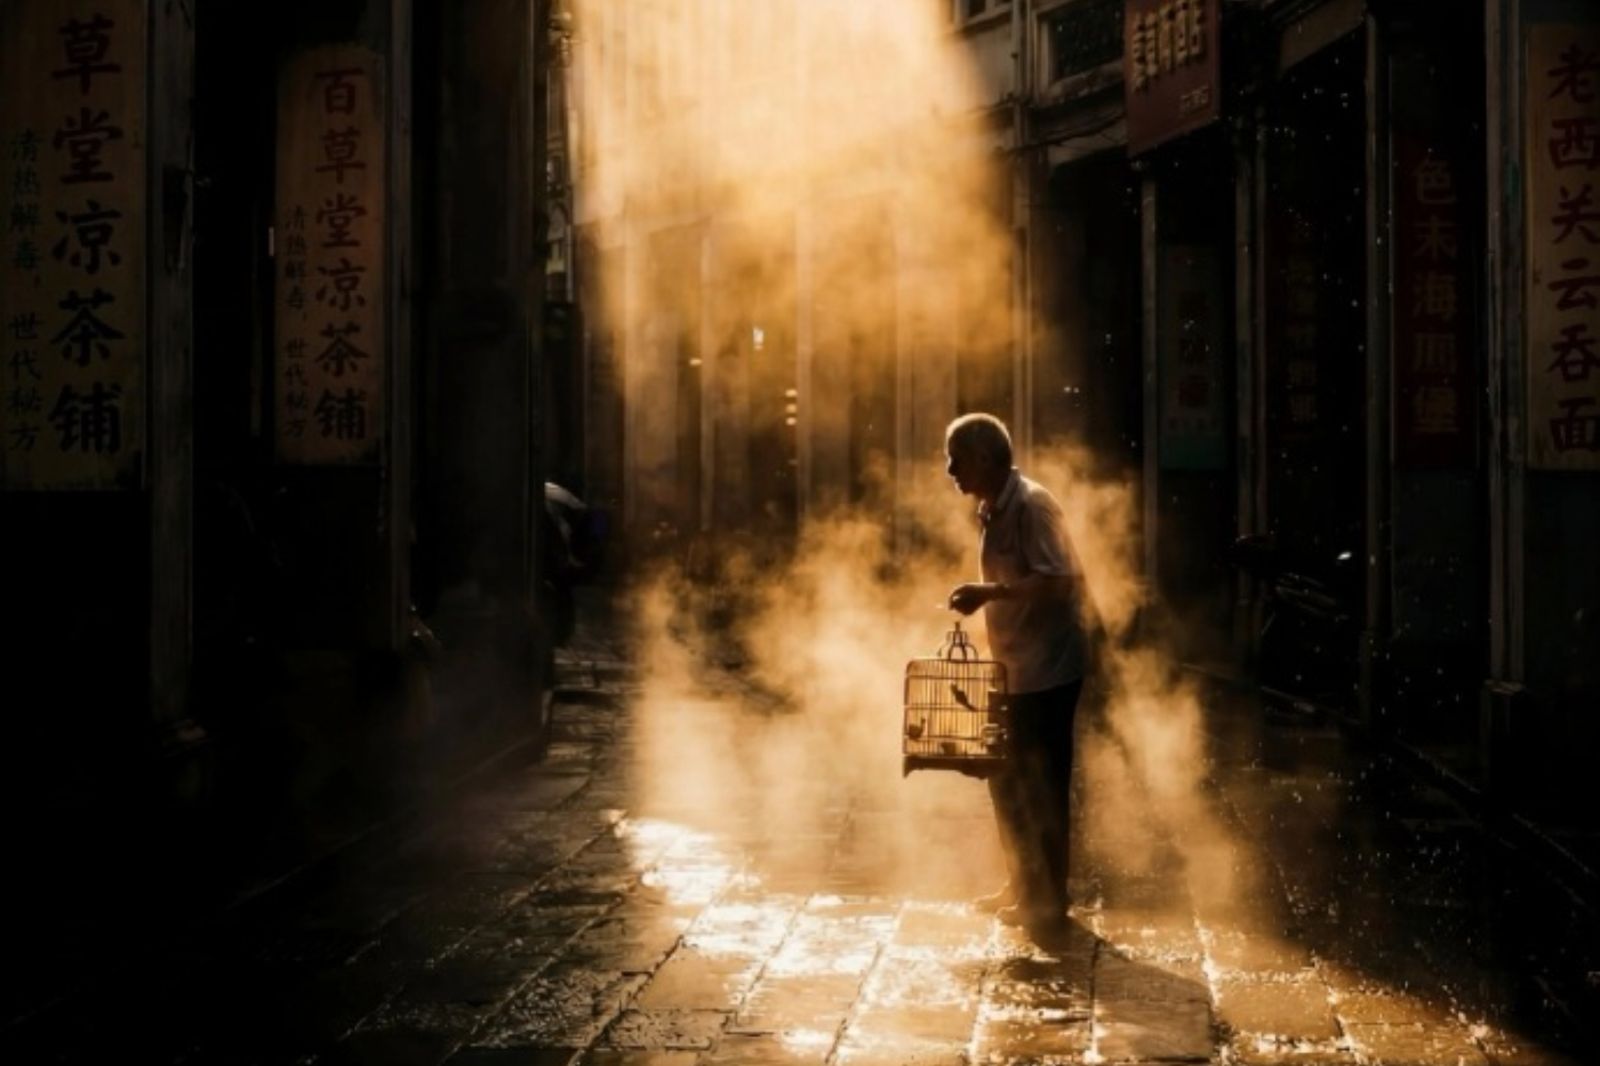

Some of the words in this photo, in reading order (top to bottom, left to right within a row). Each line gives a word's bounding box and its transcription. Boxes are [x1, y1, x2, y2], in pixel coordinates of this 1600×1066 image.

[48, 13, 122, 455] 草堂凉茶铺
[313, 67, 369, 441] 百草堂凉茶铺
[1547, 44, 1600, 454] 老西关云吞面
